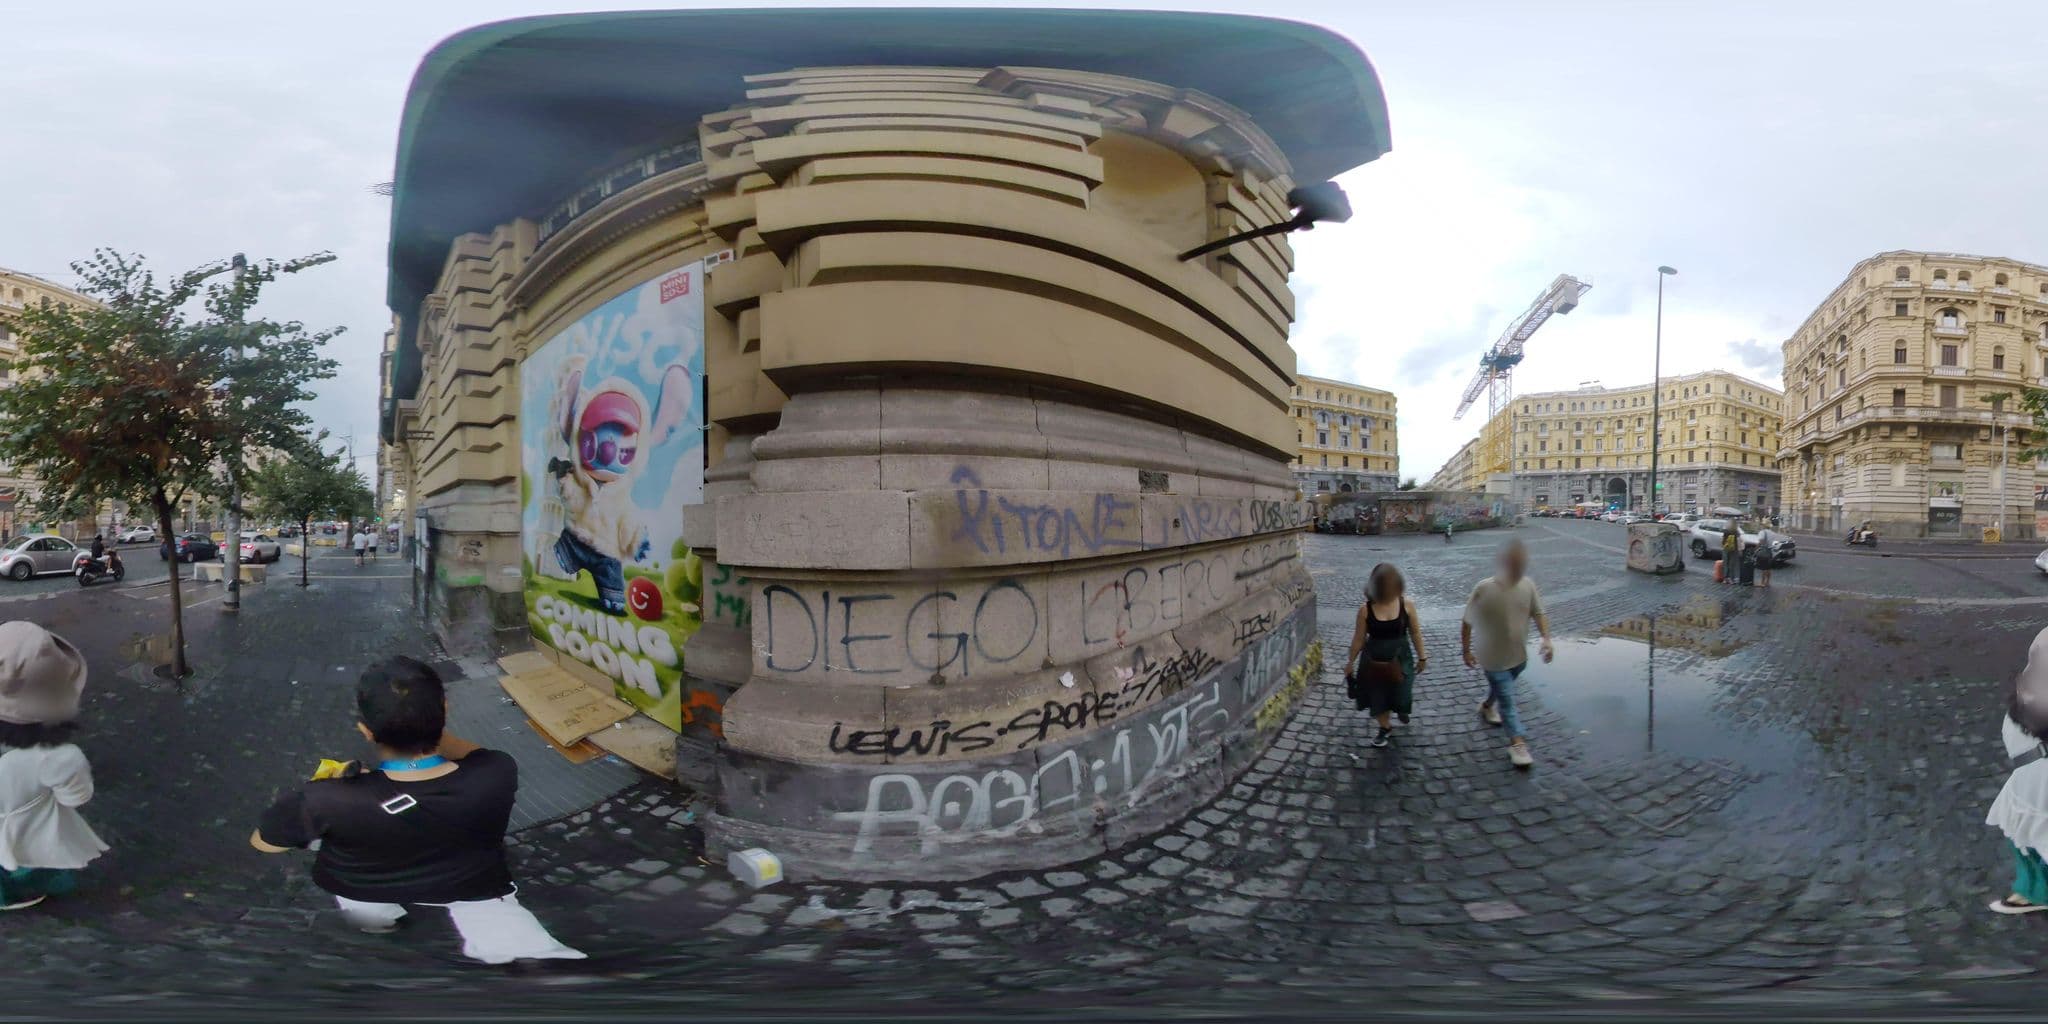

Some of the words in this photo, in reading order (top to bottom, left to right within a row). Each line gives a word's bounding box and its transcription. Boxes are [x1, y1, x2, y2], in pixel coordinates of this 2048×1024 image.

[663, 274, 687, 291] MINI
[536, 594, 678, 668] COMING
[548, 623, 663, 700] SOON
[763, 577, 1038, 677] DIEGO
